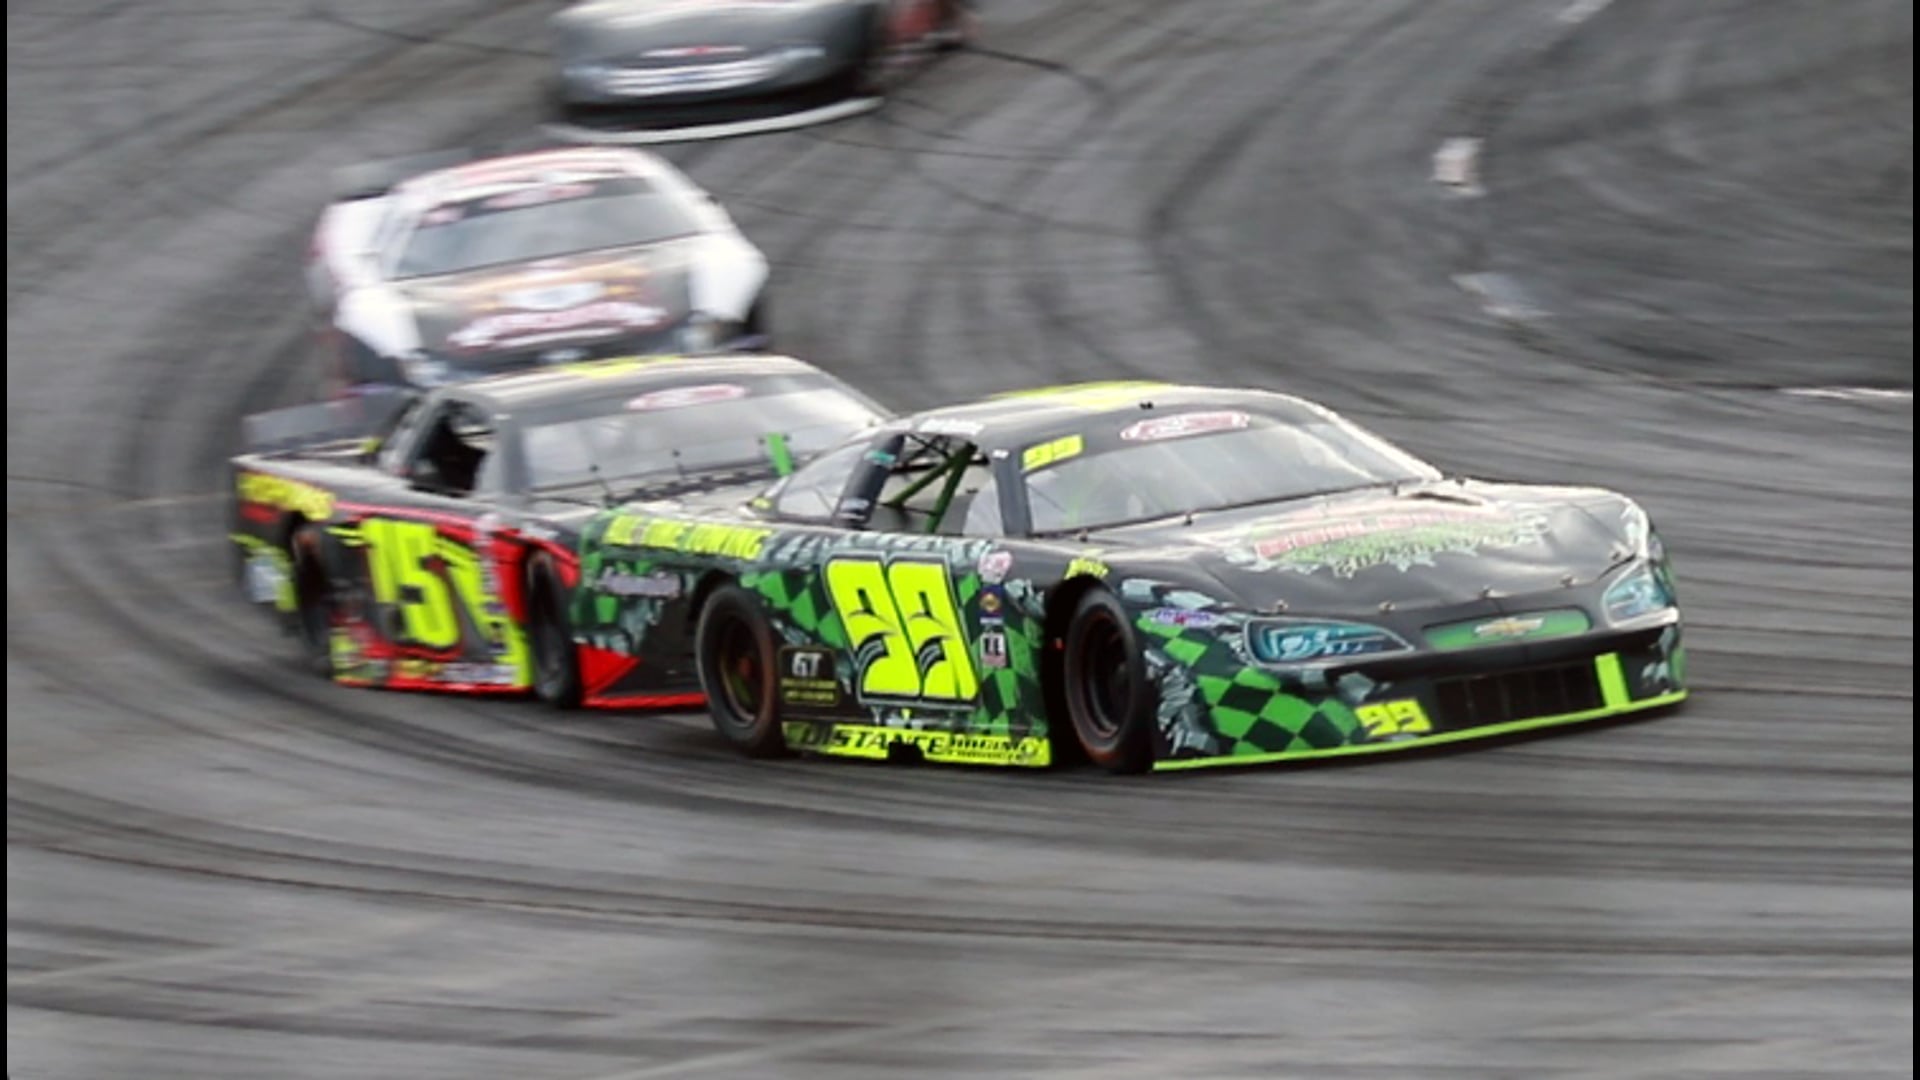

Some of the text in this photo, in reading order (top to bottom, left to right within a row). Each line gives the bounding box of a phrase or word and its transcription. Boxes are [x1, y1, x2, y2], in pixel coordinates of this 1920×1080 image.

[1020, 435, 1083, 472] 99
[826, 558, 979, 701] 99
[792, 652, 823, 678] GT
[1354, 699, 1431, 738] 99
